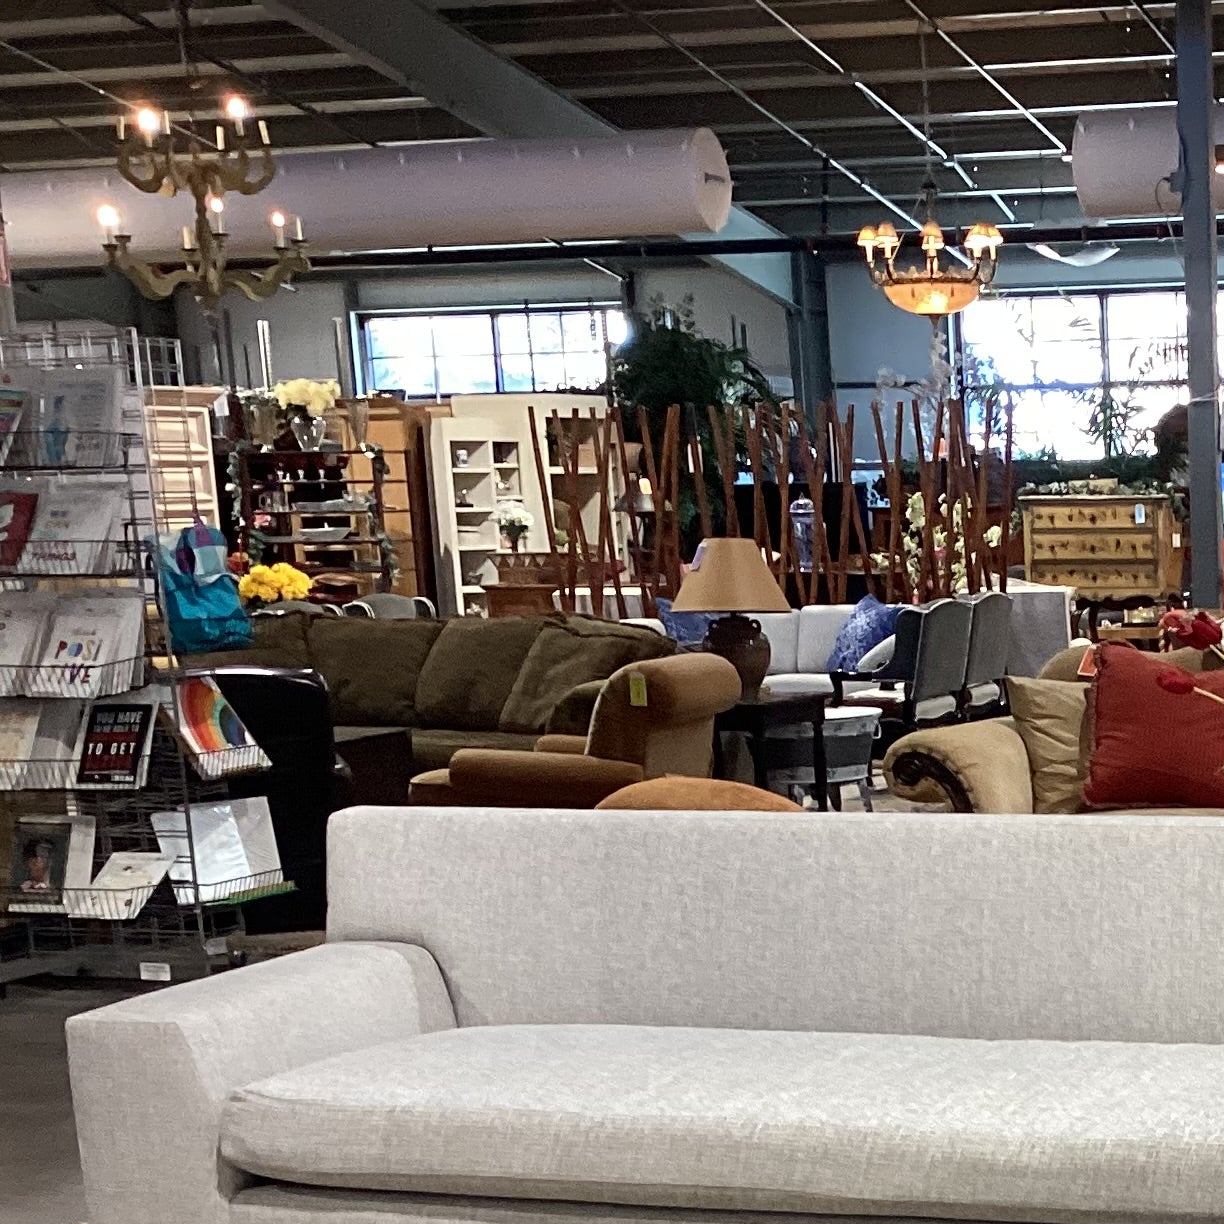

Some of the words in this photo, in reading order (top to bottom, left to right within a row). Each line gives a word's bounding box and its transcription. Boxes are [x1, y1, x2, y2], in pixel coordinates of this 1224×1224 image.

[117, 711, 144, 725] HAVE
[87, 742, 104, 755] TO
[110, 742, 136, 755] GET
